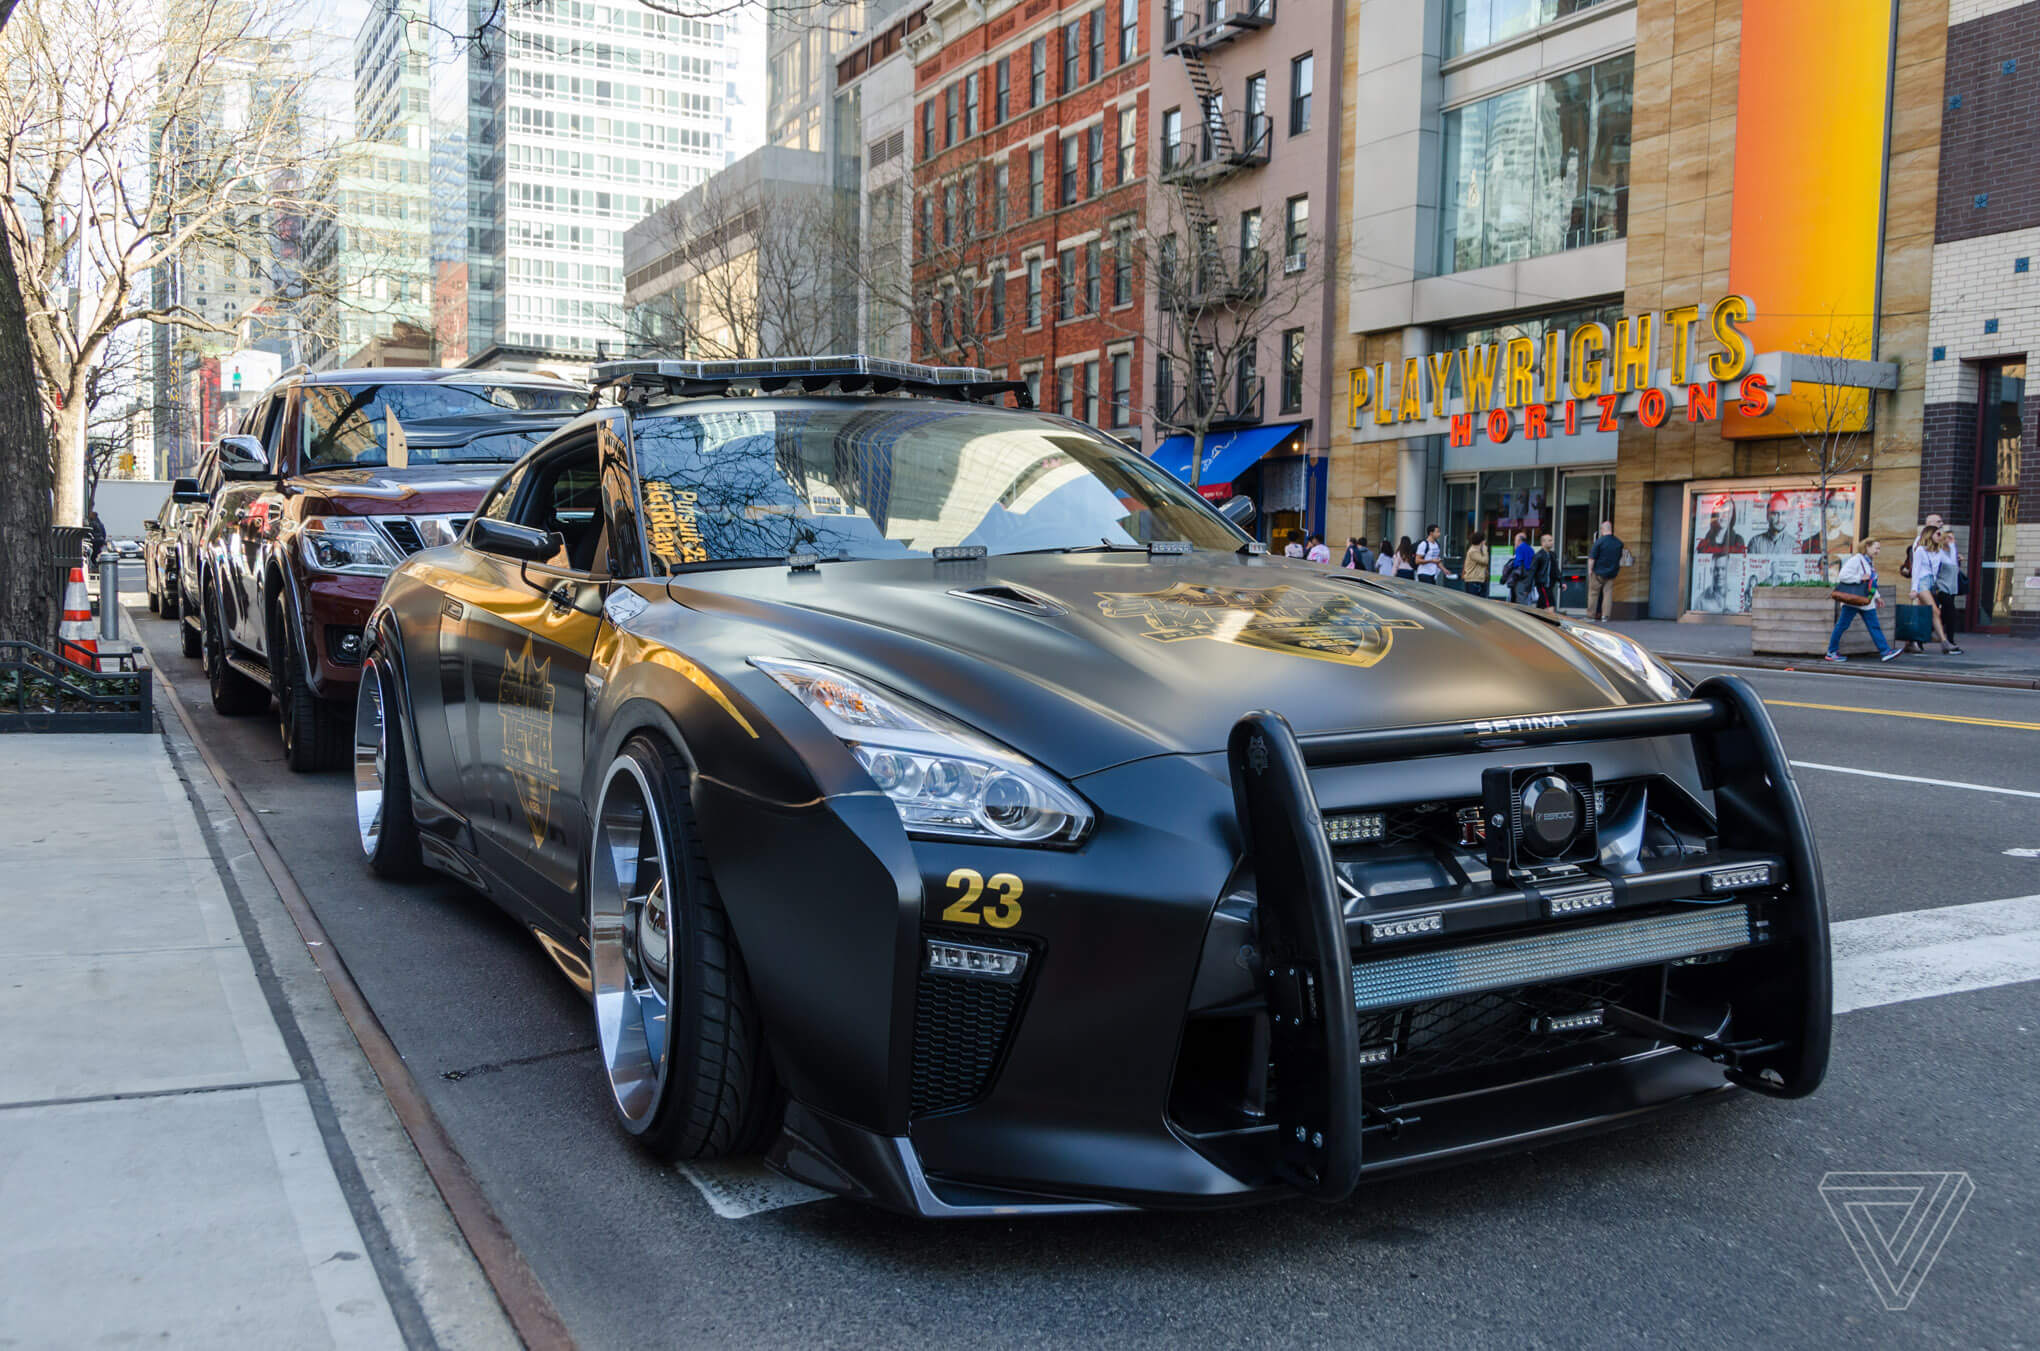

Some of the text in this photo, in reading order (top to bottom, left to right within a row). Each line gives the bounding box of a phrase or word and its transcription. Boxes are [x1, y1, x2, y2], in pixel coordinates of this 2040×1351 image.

[1347, 294, 1757, 429] PLAYWRIGHTS
[1450, 373, 1777, 448] HORIZONS
[646, 481, 678, 557] #GTRLaw
[675, 490, 704, 543] Pursuit
[1474, 714, 1569, 736] SETINA
[942, 868, 1024, 929] 23
